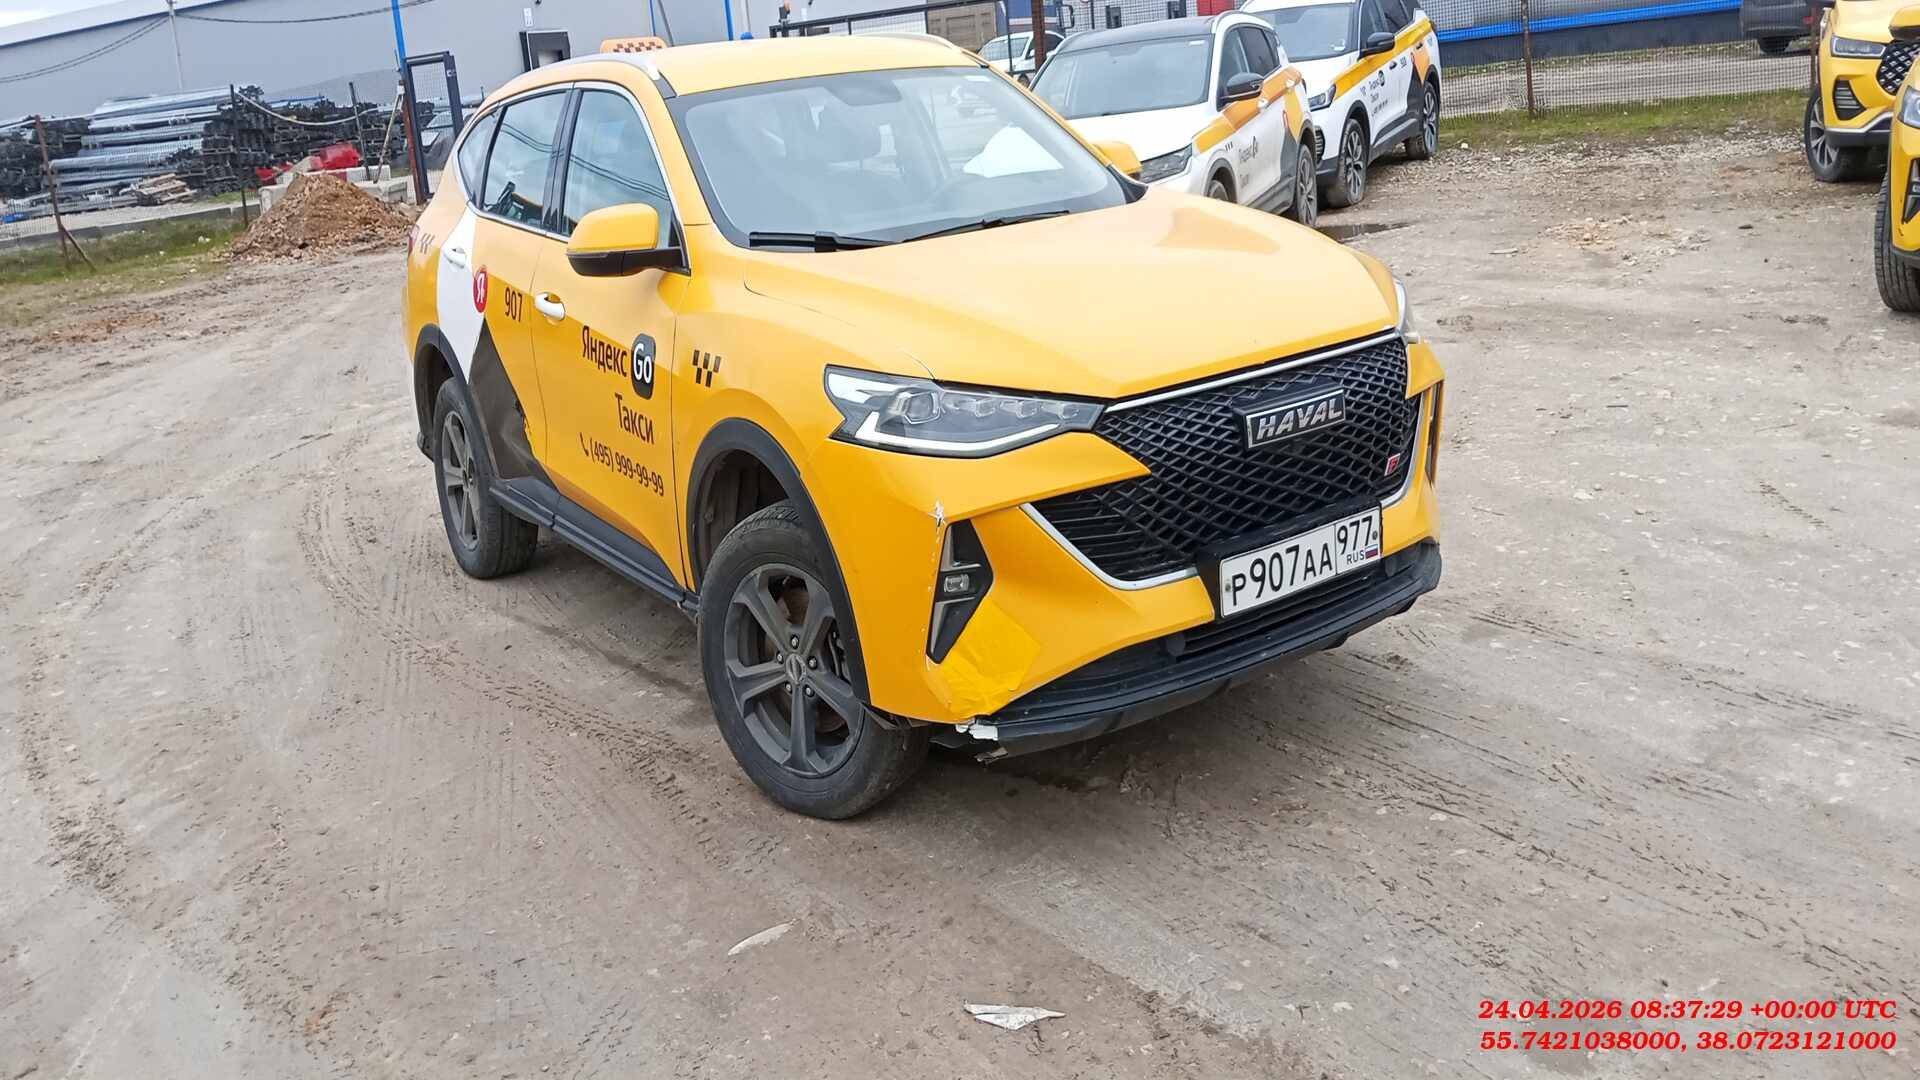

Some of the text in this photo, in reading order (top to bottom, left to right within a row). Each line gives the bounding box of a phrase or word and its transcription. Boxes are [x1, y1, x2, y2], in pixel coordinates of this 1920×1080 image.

[504, 287, 523, 323] 907
[582, 325, 653, 384] Яндекс Go
[615, 392, 655, 445] Такси
[1256, 398, 1343, 440] HAVAL
[590, 437, 664, 497] (495) 999-99-99
[1337, 515, 1373, 555] 977
[1346, 549, 1366, 565] RUS
